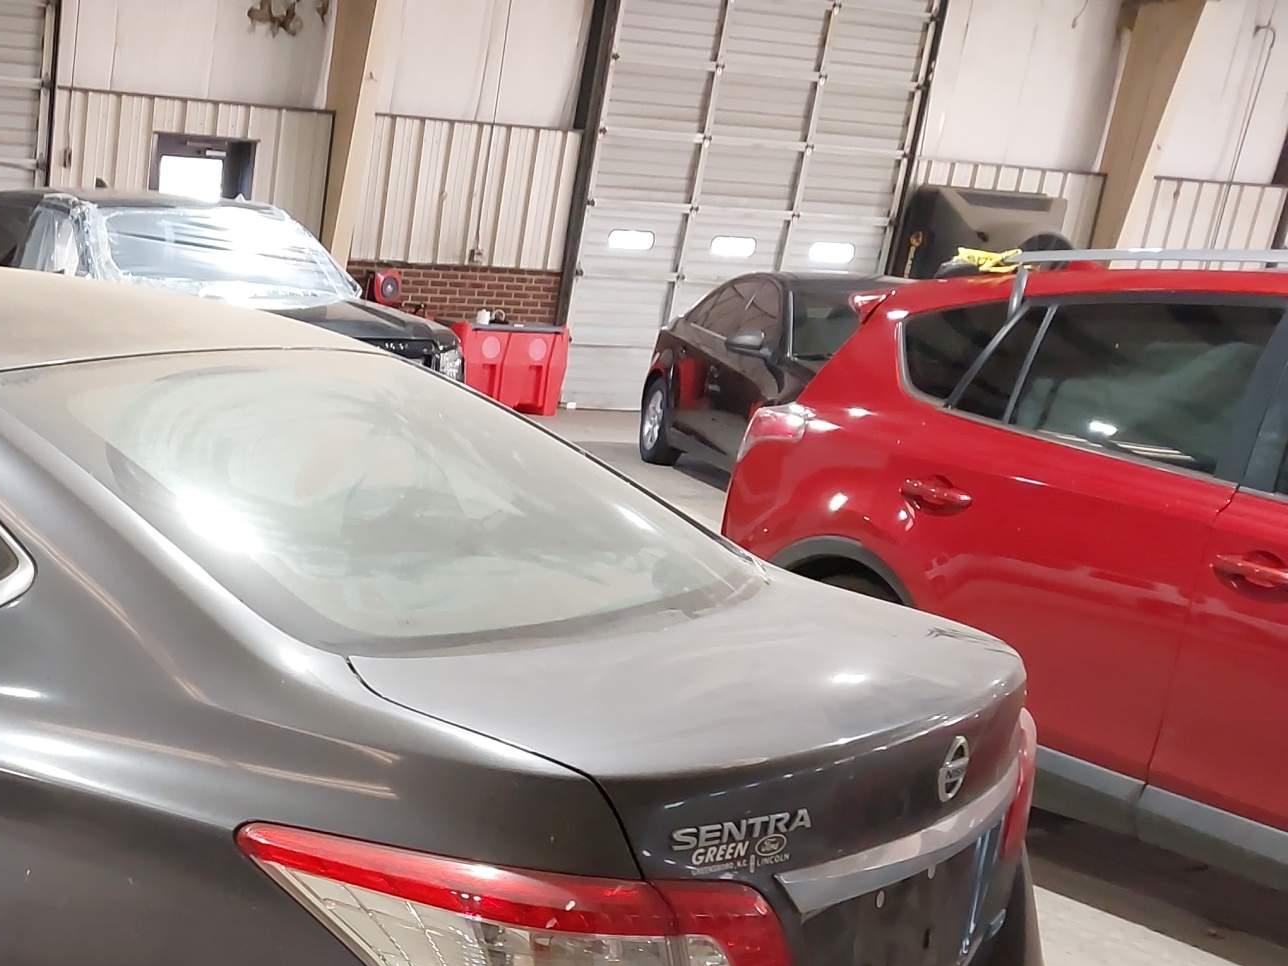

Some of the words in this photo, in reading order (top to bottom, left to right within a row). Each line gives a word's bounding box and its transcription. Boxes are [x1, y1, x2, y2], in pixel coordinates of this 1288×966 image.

[672, 808, 812, 851] SENTRA
[692, 841, 749, 866] GREEN
[756, 852, 791, 867] LINCOLN
